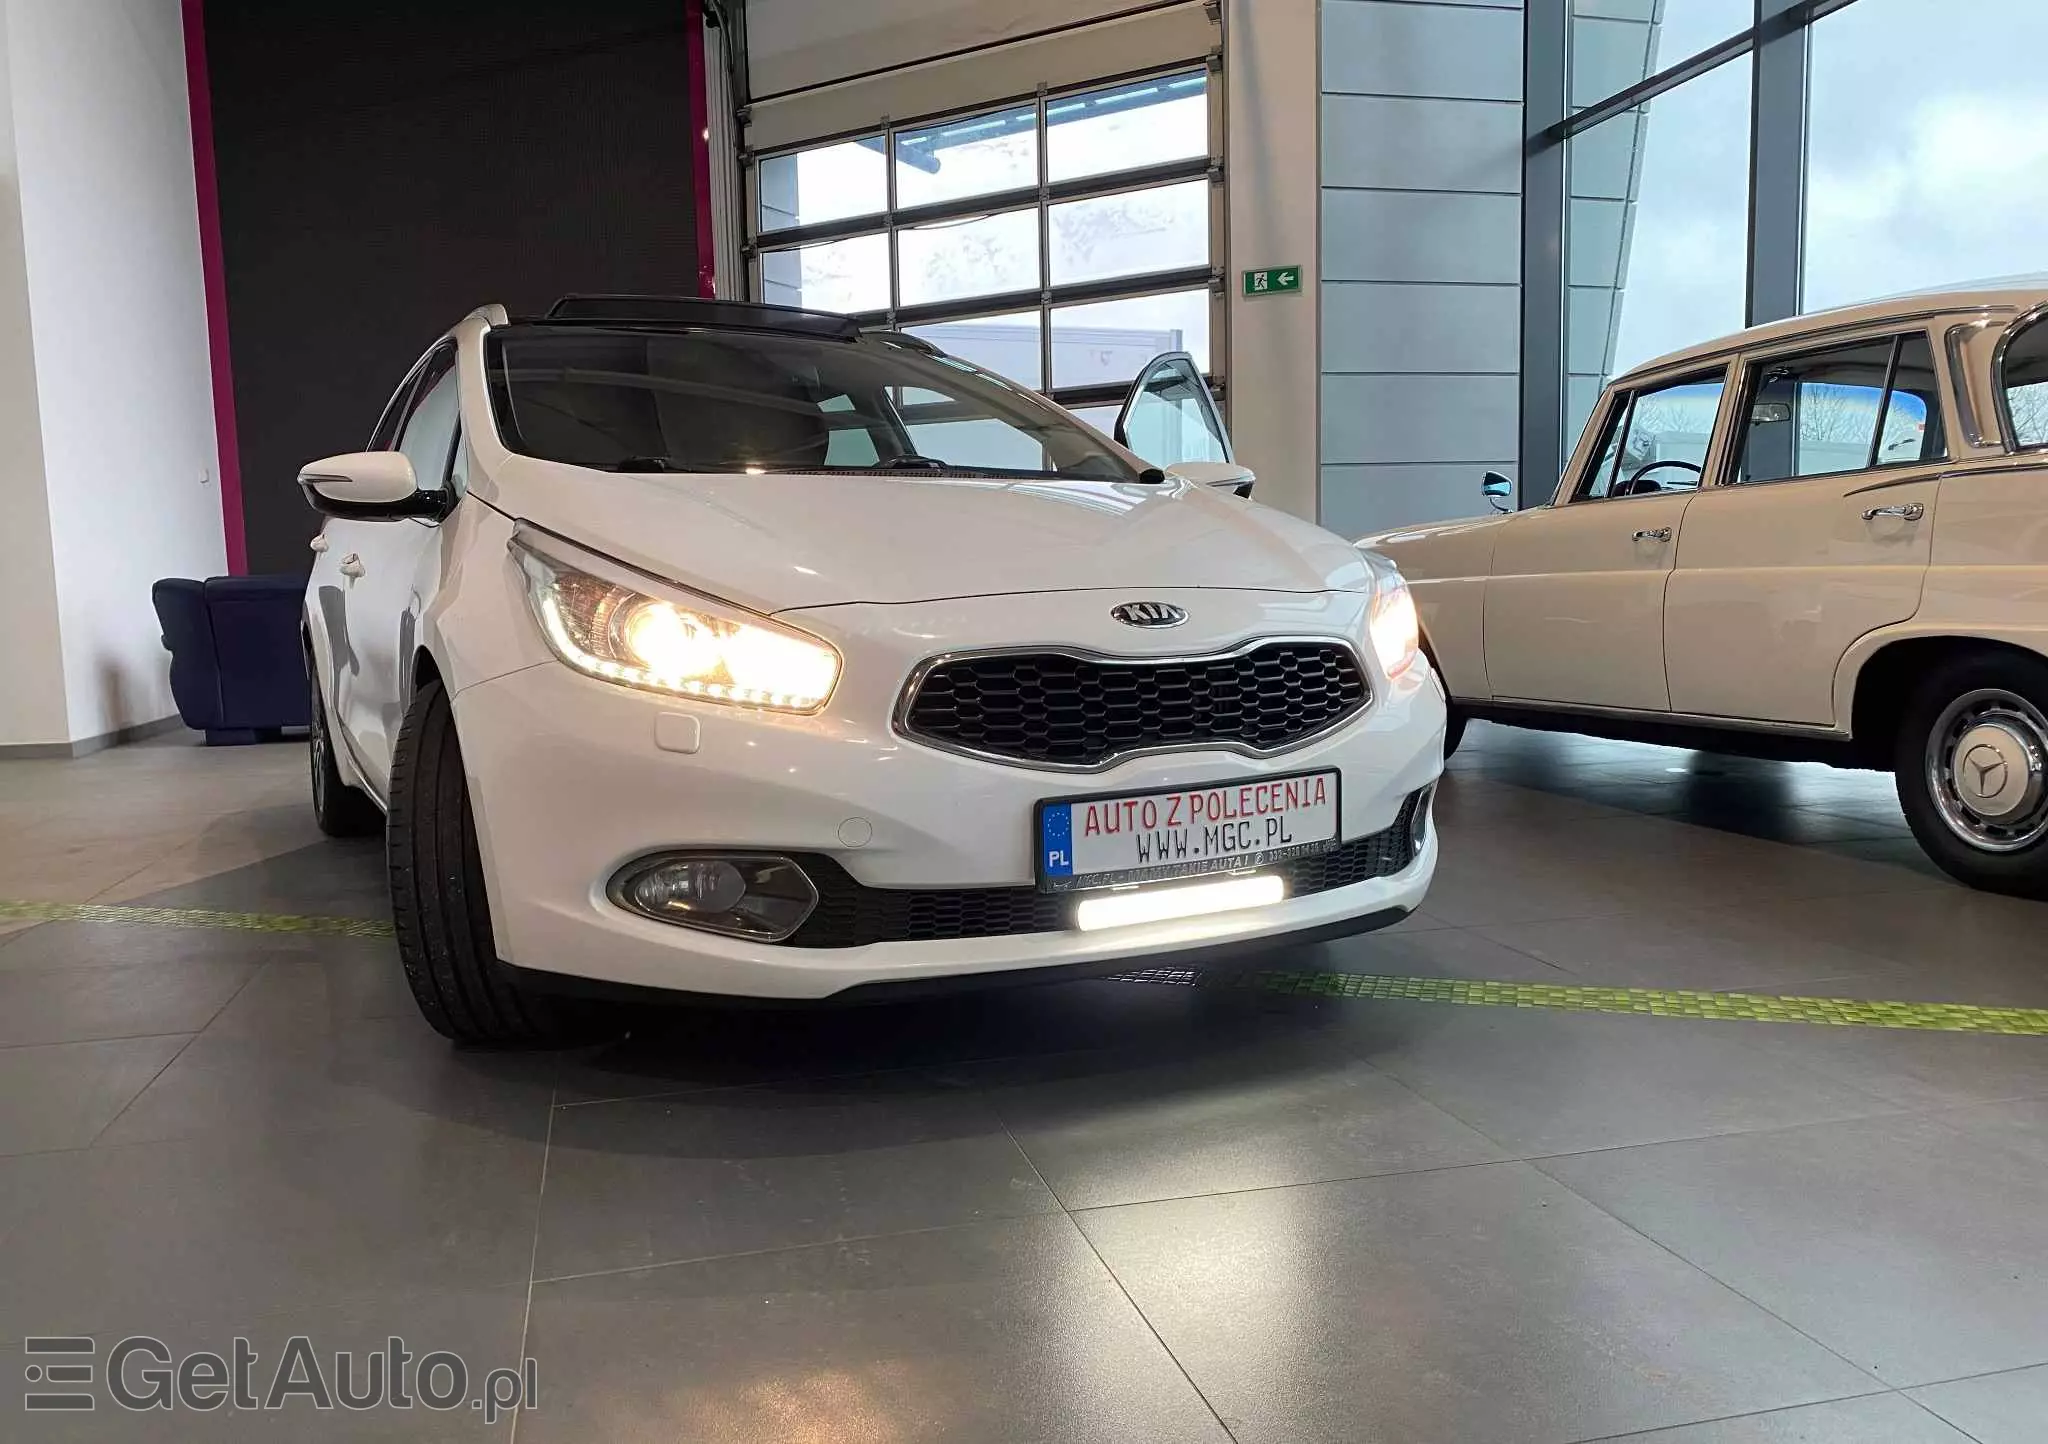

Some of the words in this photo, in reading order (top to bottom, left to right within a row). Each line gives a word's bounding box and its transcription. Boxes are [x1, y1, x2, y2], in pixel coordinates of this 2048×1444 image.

[1122, 603, 1180, 621] KIA
[1084, 799, 1157, 837] AUTO
[1167, 796, 1182, 829] Z
[1189, 777, 1327, 825] POLECENIA
[1136, 816, 1293, 864] WWW.MGC.PL
[1048, 851, 1070, 868] PL
